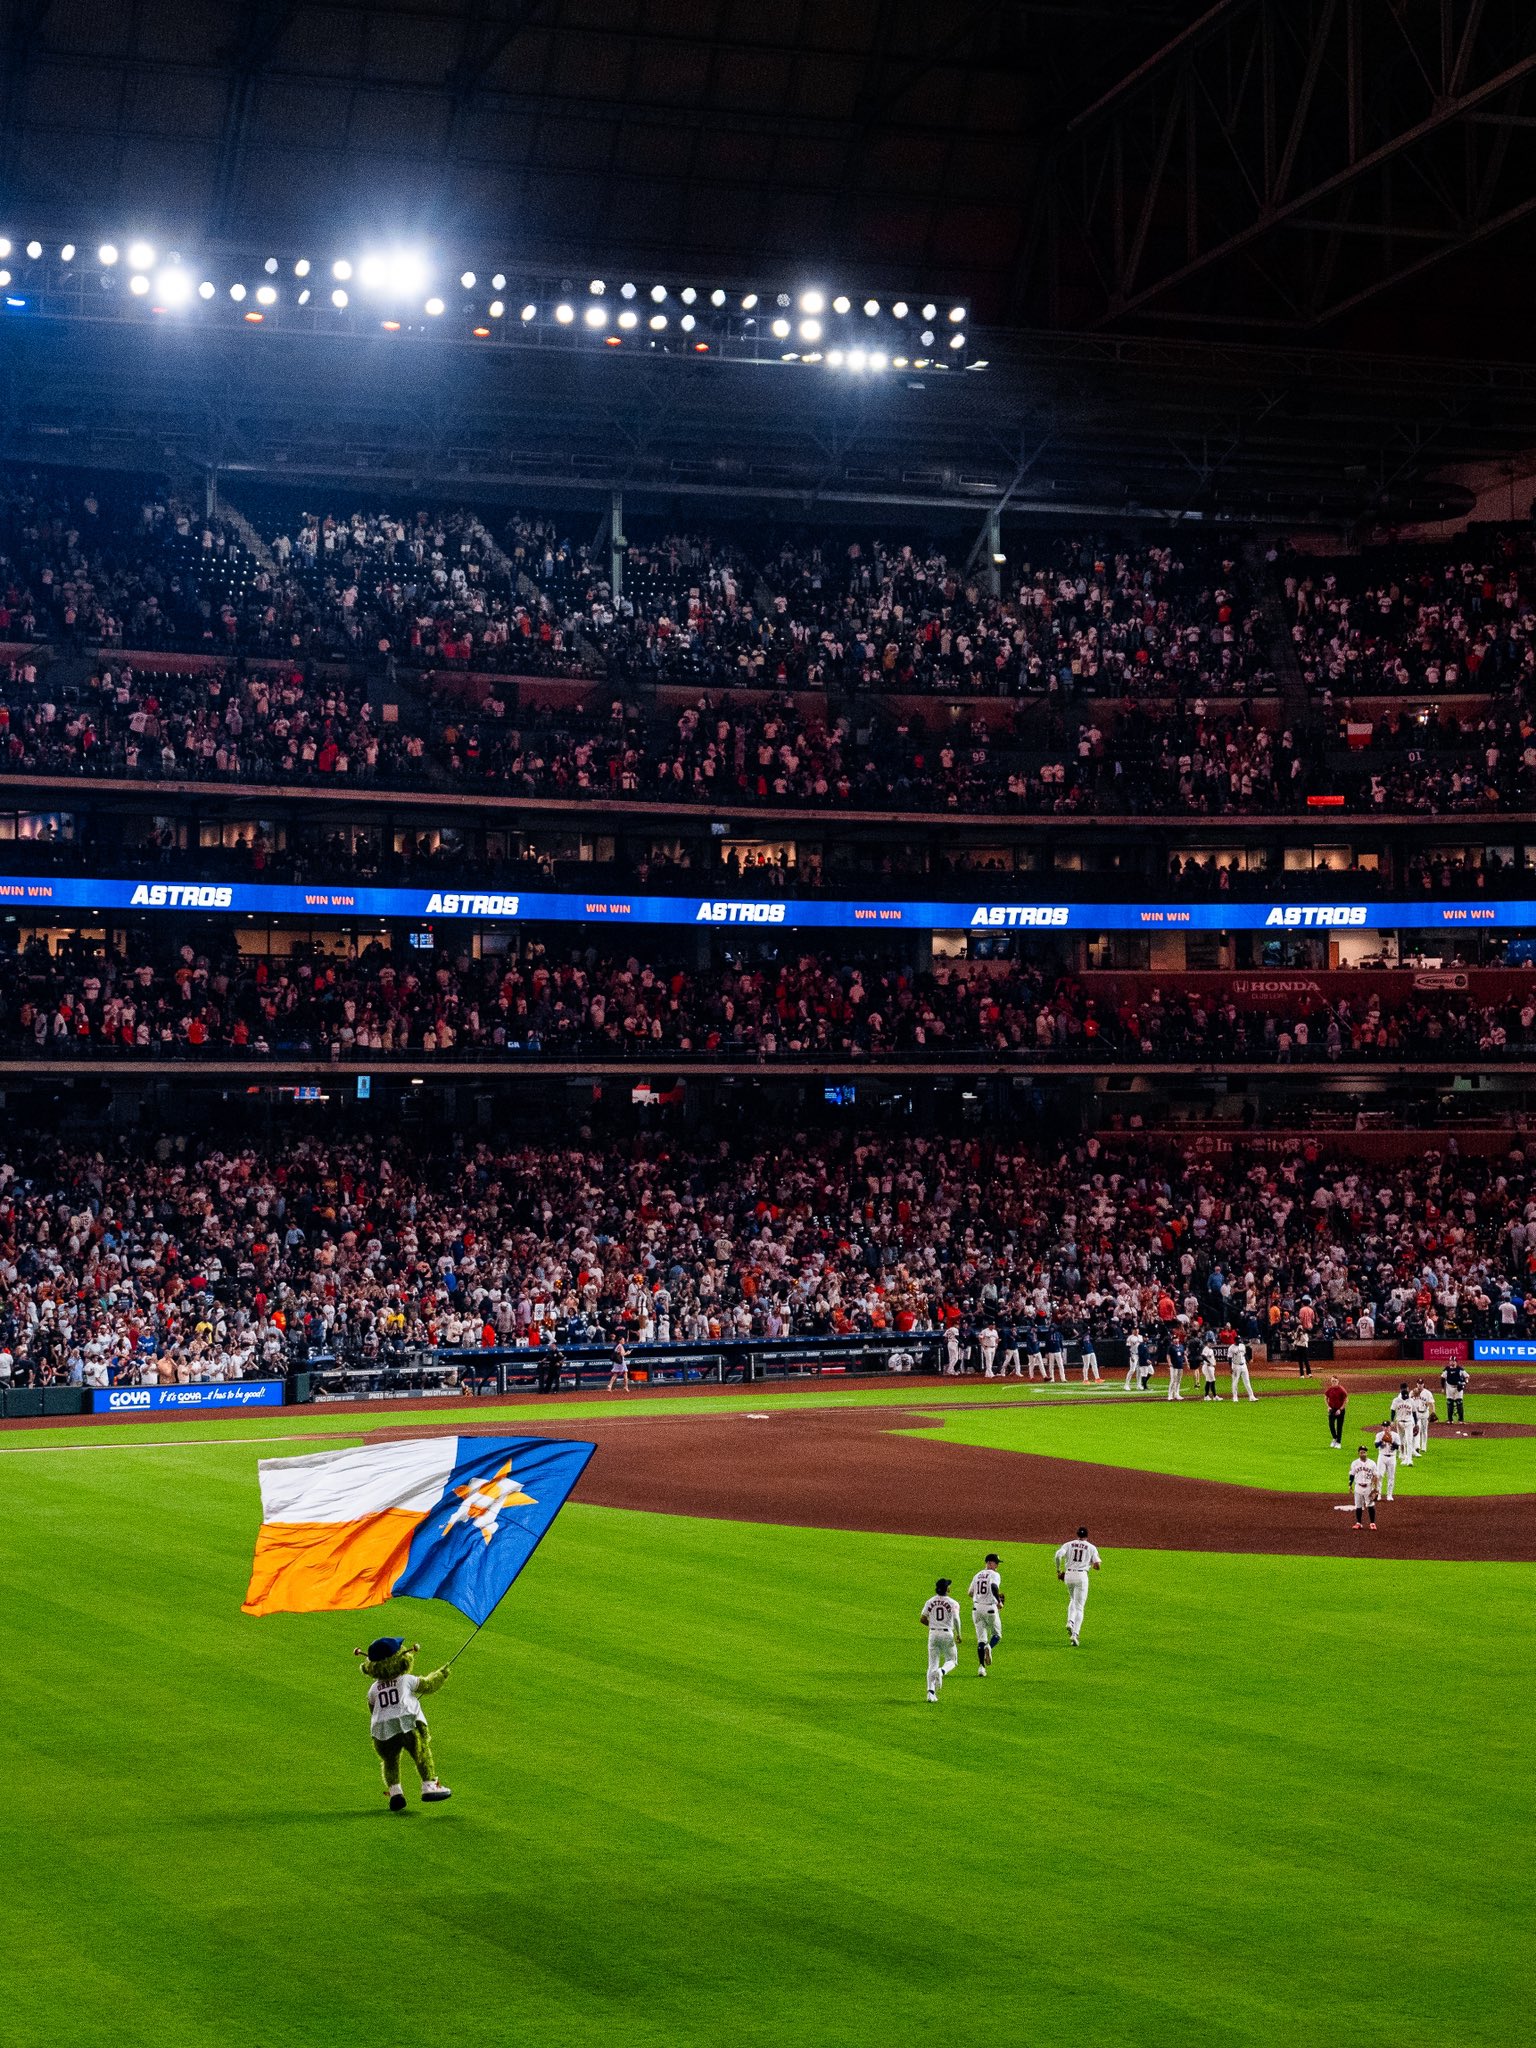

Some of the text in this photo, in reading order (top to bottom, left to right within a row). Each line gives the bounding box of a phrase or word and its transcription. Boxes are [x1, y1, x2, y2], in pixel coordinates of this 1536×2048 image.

[0, 885, 53, 897] WIN WIN
[130, 884, 233, 907] ASTROS
[305, 894, 355, 905] WIN WIN
[425, 893, 520, 915] ASTROS
[585, 903, 631, 914] WIN WIN
[695, 902, 786, 922] ASTROS
[854, 909, 902, 919] WIN WIN
[1443, 909, 1495, 919] WIN WIN
[970, 907, 1069, 926] ASTROS
[1140, 912, 1190, 921] WIN WIN
[1265, 906, 1368, 926] ASTROS
[1250, 981, 1322, 991] HONDA
[1430, 1345, 1459, 1355] reliant
[1479, 1346, 1536, 1355] UNITED
[109, 1391, 151, 1406] GOYA
[177, 1391, 202, 1402] GOYA
[213, 1388, 227, 1400] has
[227, 1390, 235, 1400] to
[235, 1387, 244, 1399] be
[1073, 1549, 1083, 1562] 11
[977, 1581, 987, 1595] 16
[936, 1607, 944, 1621] 0
[377, 1680, 398, 1691] ORBIT
[378, 1688, 400, 1708] 00
